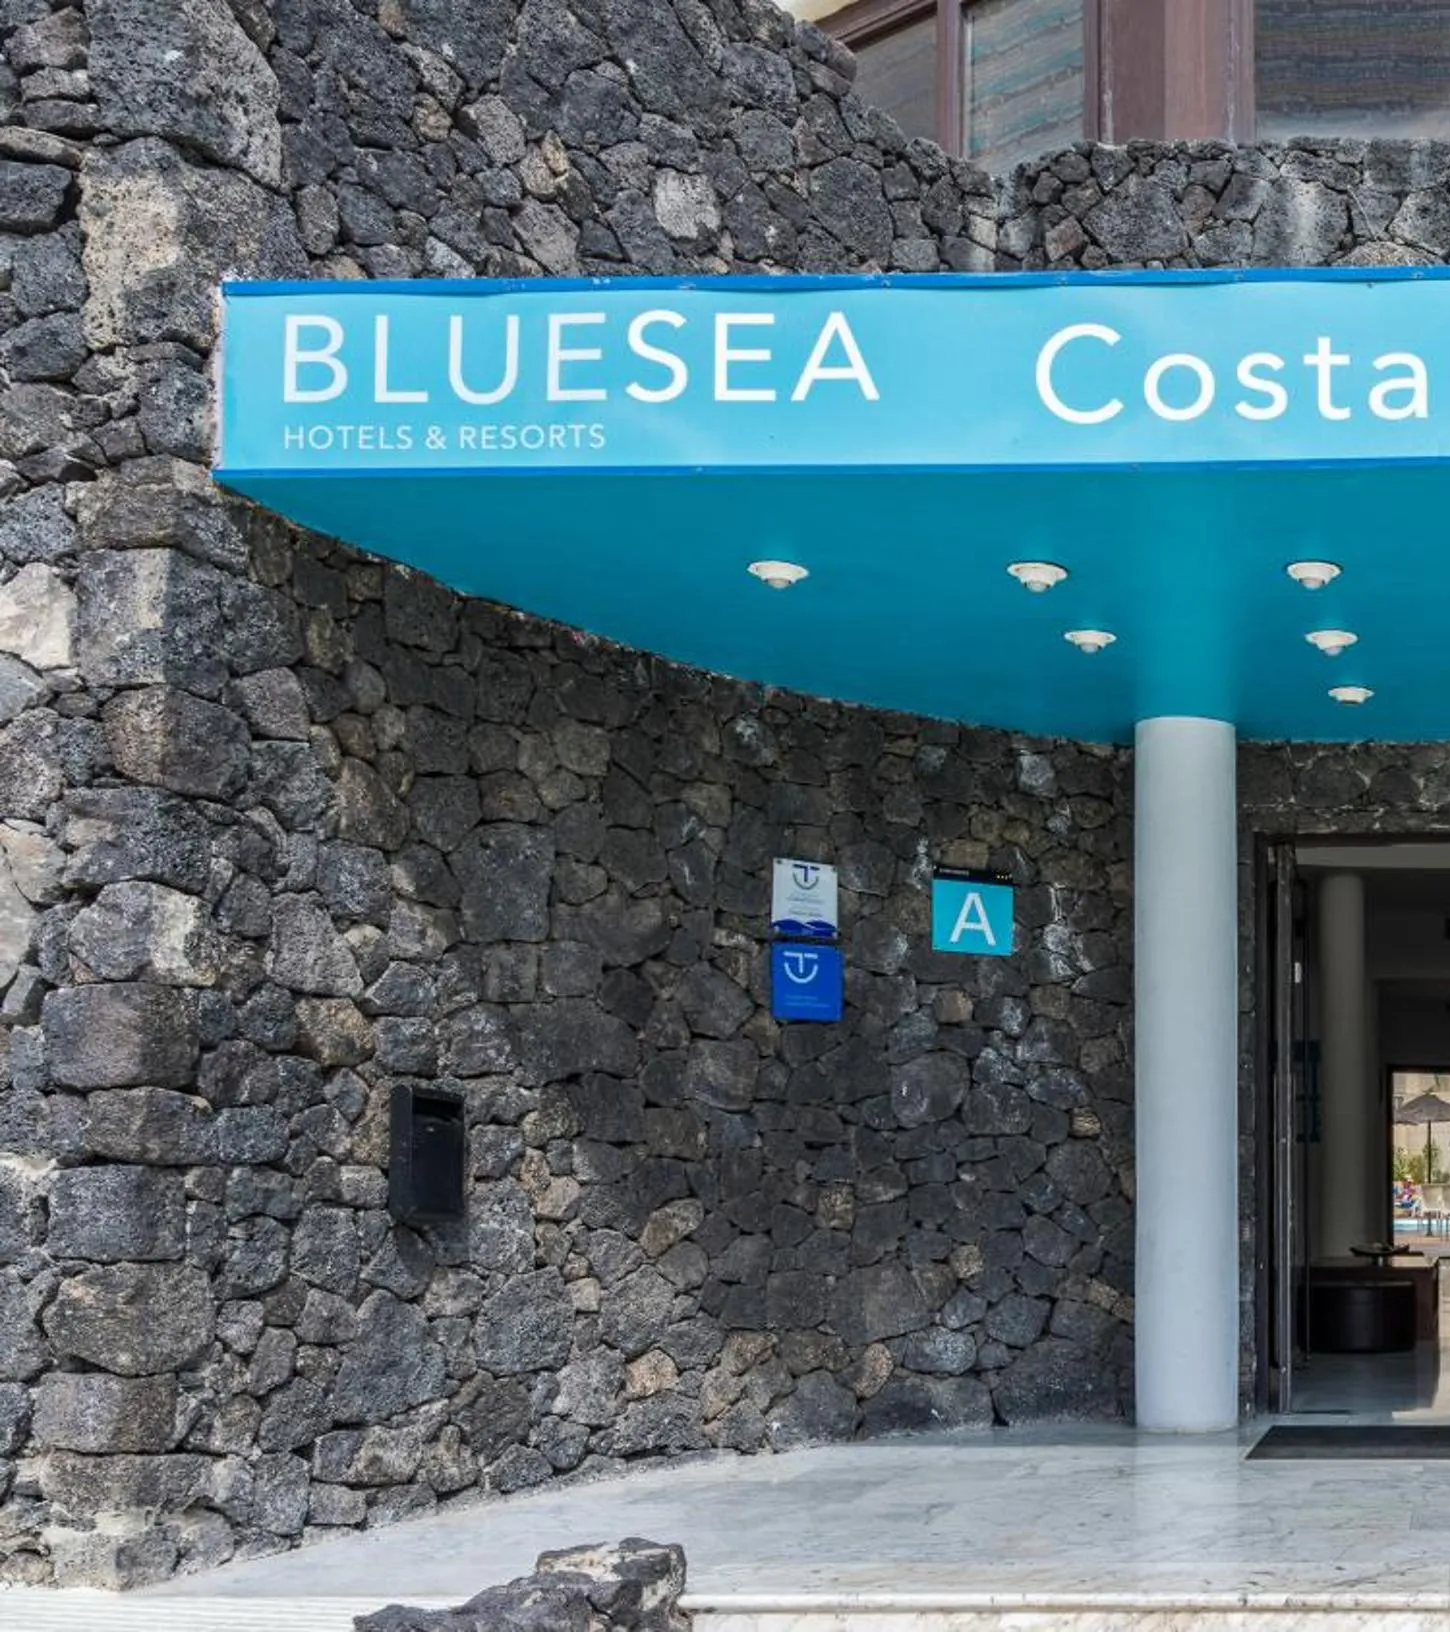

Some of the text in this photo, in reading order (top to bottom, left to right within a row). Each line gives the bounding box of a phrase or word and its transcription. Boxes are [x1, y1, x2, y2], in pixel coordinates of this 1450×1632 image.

[283, 309, 880, 403] BLUESEA
[1035, 322, 1430, 425] Costa
[283, 423, 607, 451] HOTELS & RESORTS
[948, 892, 997, 947] A
